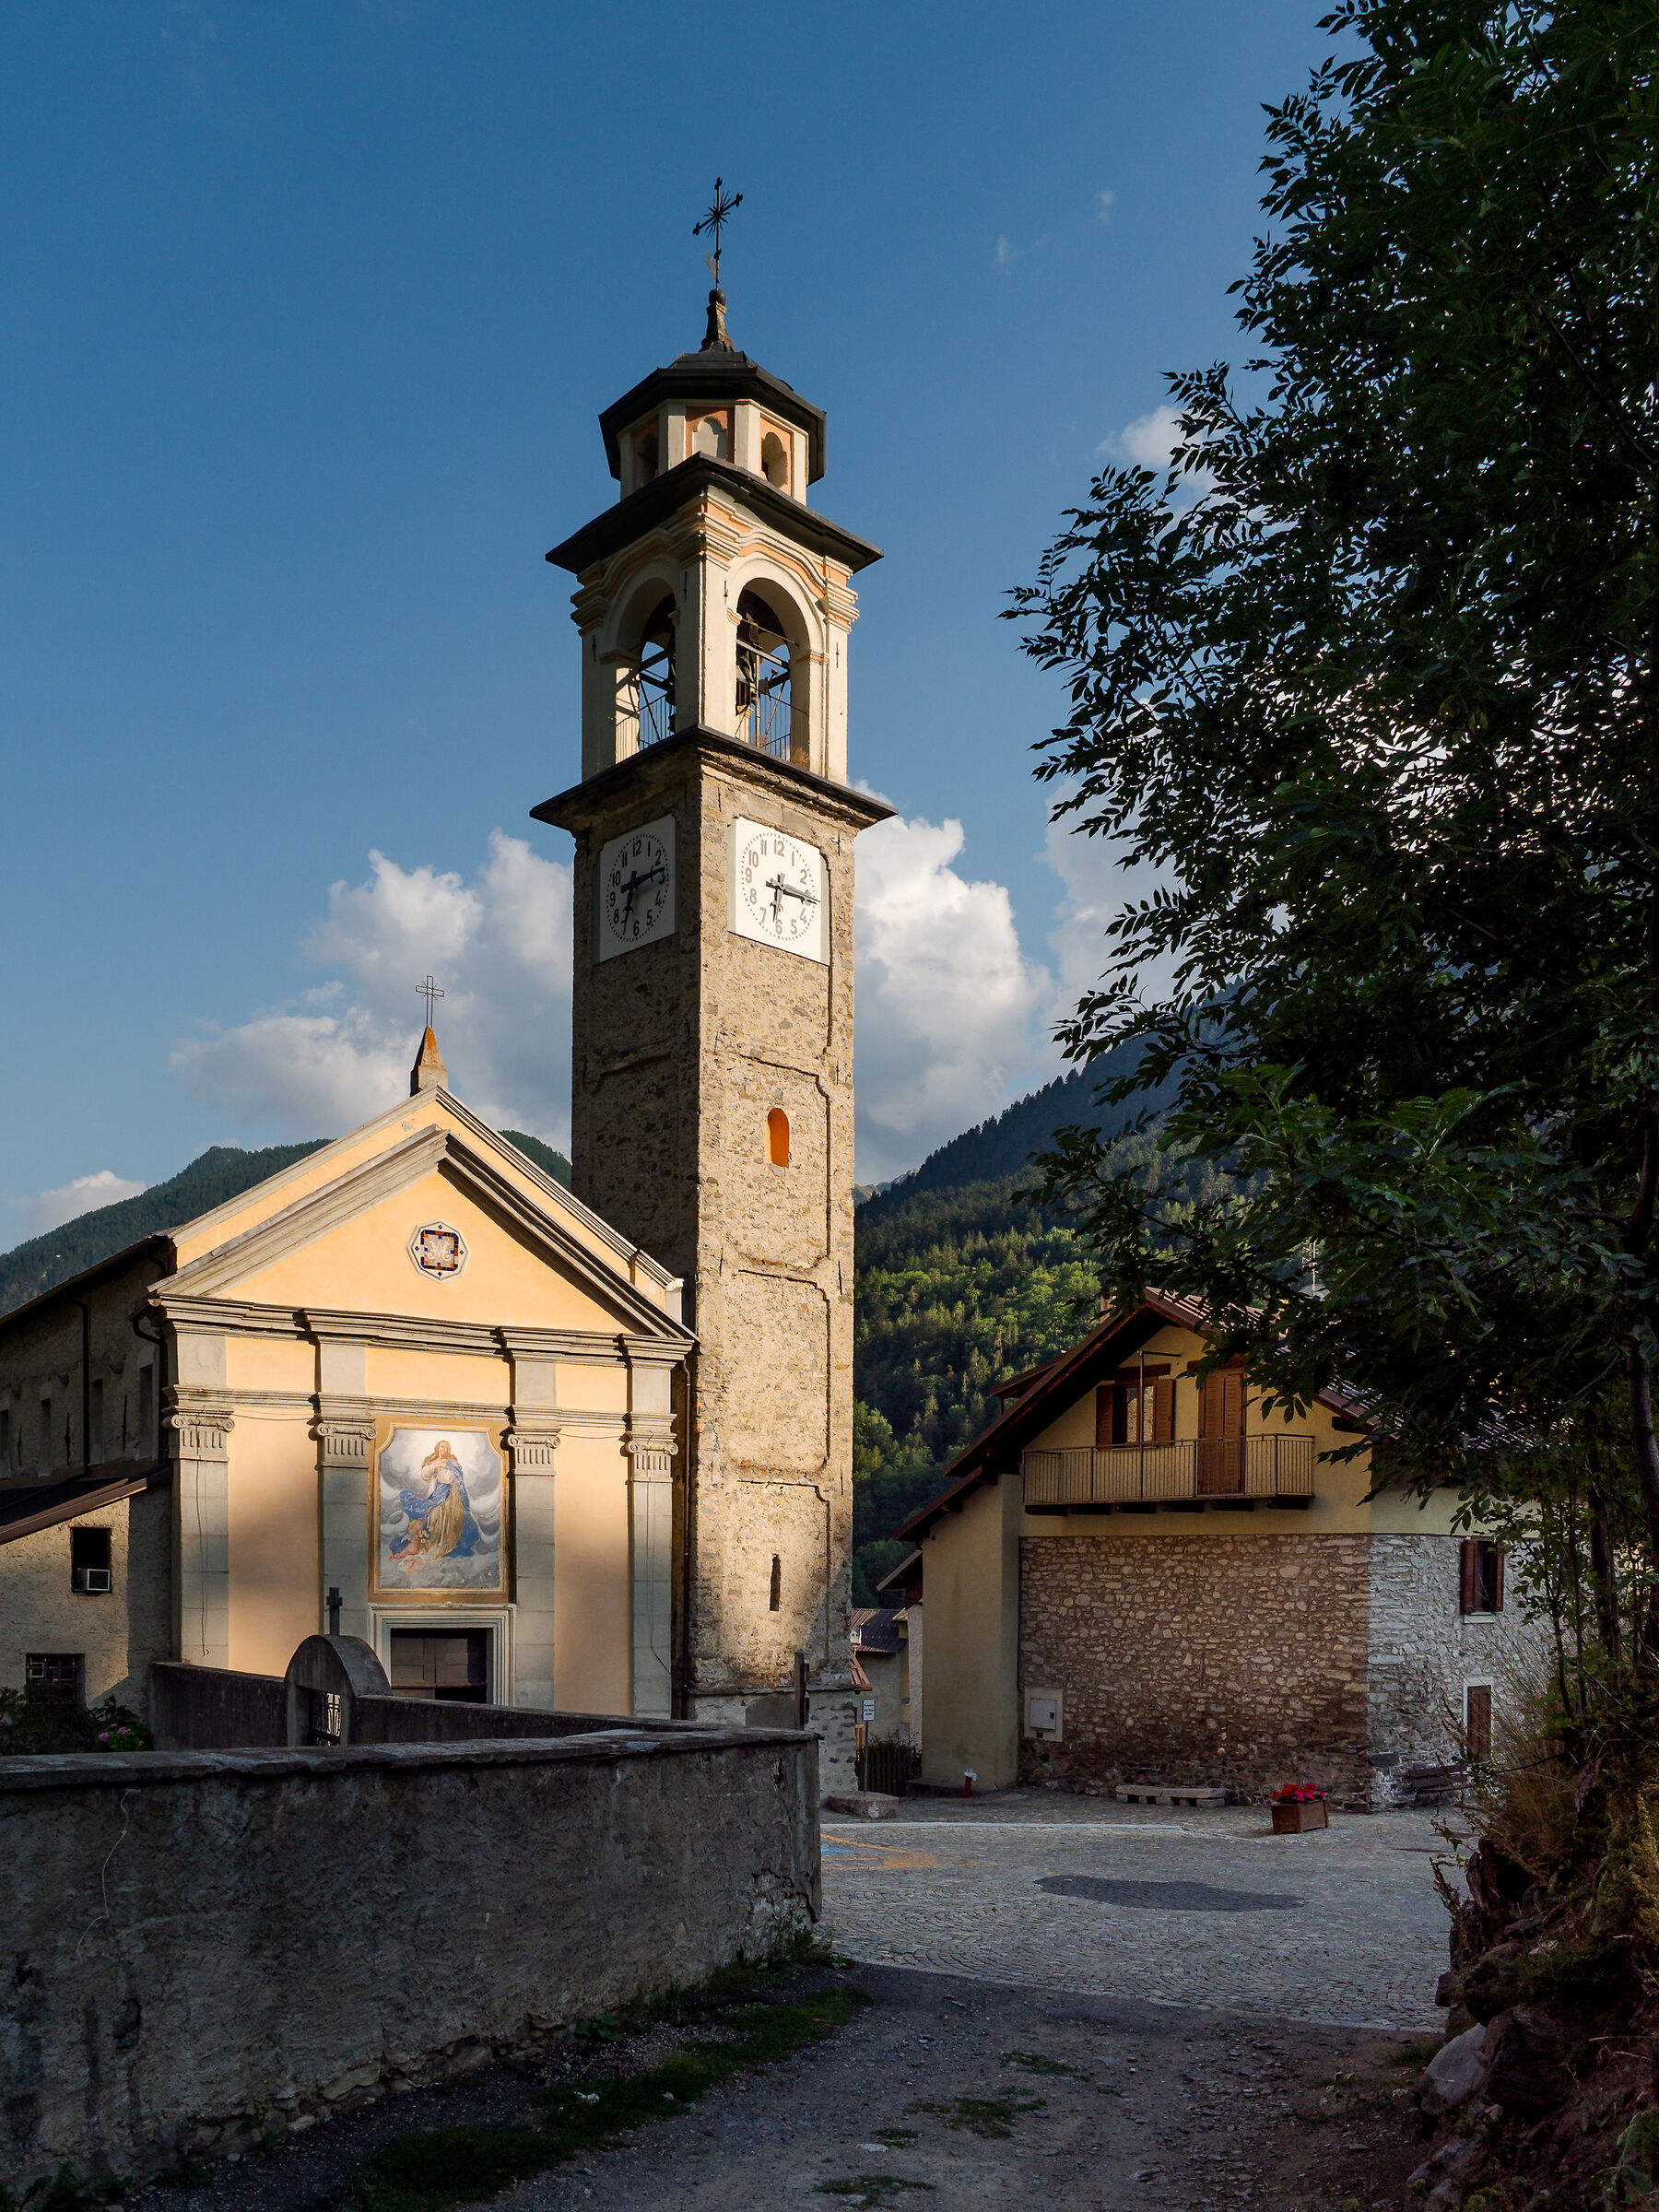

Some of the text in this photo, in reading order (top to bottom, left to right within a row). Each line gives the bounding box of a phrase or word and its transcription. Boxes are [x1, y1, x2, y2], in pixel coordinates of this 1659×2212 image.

[632, 839, 641, 857] 12
[760, 839, 767, 856] 11
[774, 839, 784, 857] 12
[621, 851, 628, 868] 11
[654, 849, 662, 866] 2
[748, 850, 759, 868] 10
[791, 851, 794, 867] 1
[612, 870, 621, 888] 10
[745, 867, 752, 884] 9
[799, 868, 807, 885] 2
[609, 891, 616, 908] 9
[654, 889, 661, 907] 4
[749, 888, 758, 905] 8
[613, 908, 619, 924] 8
[646, 909, 653, 926] 5
[759, 907, 767, 924] 7
[799, 907, 807, 924] 4
[633, 920, 640, 936] 6
[775, 919, 782, 935] 6
[790, 918, 797, 935] 5
